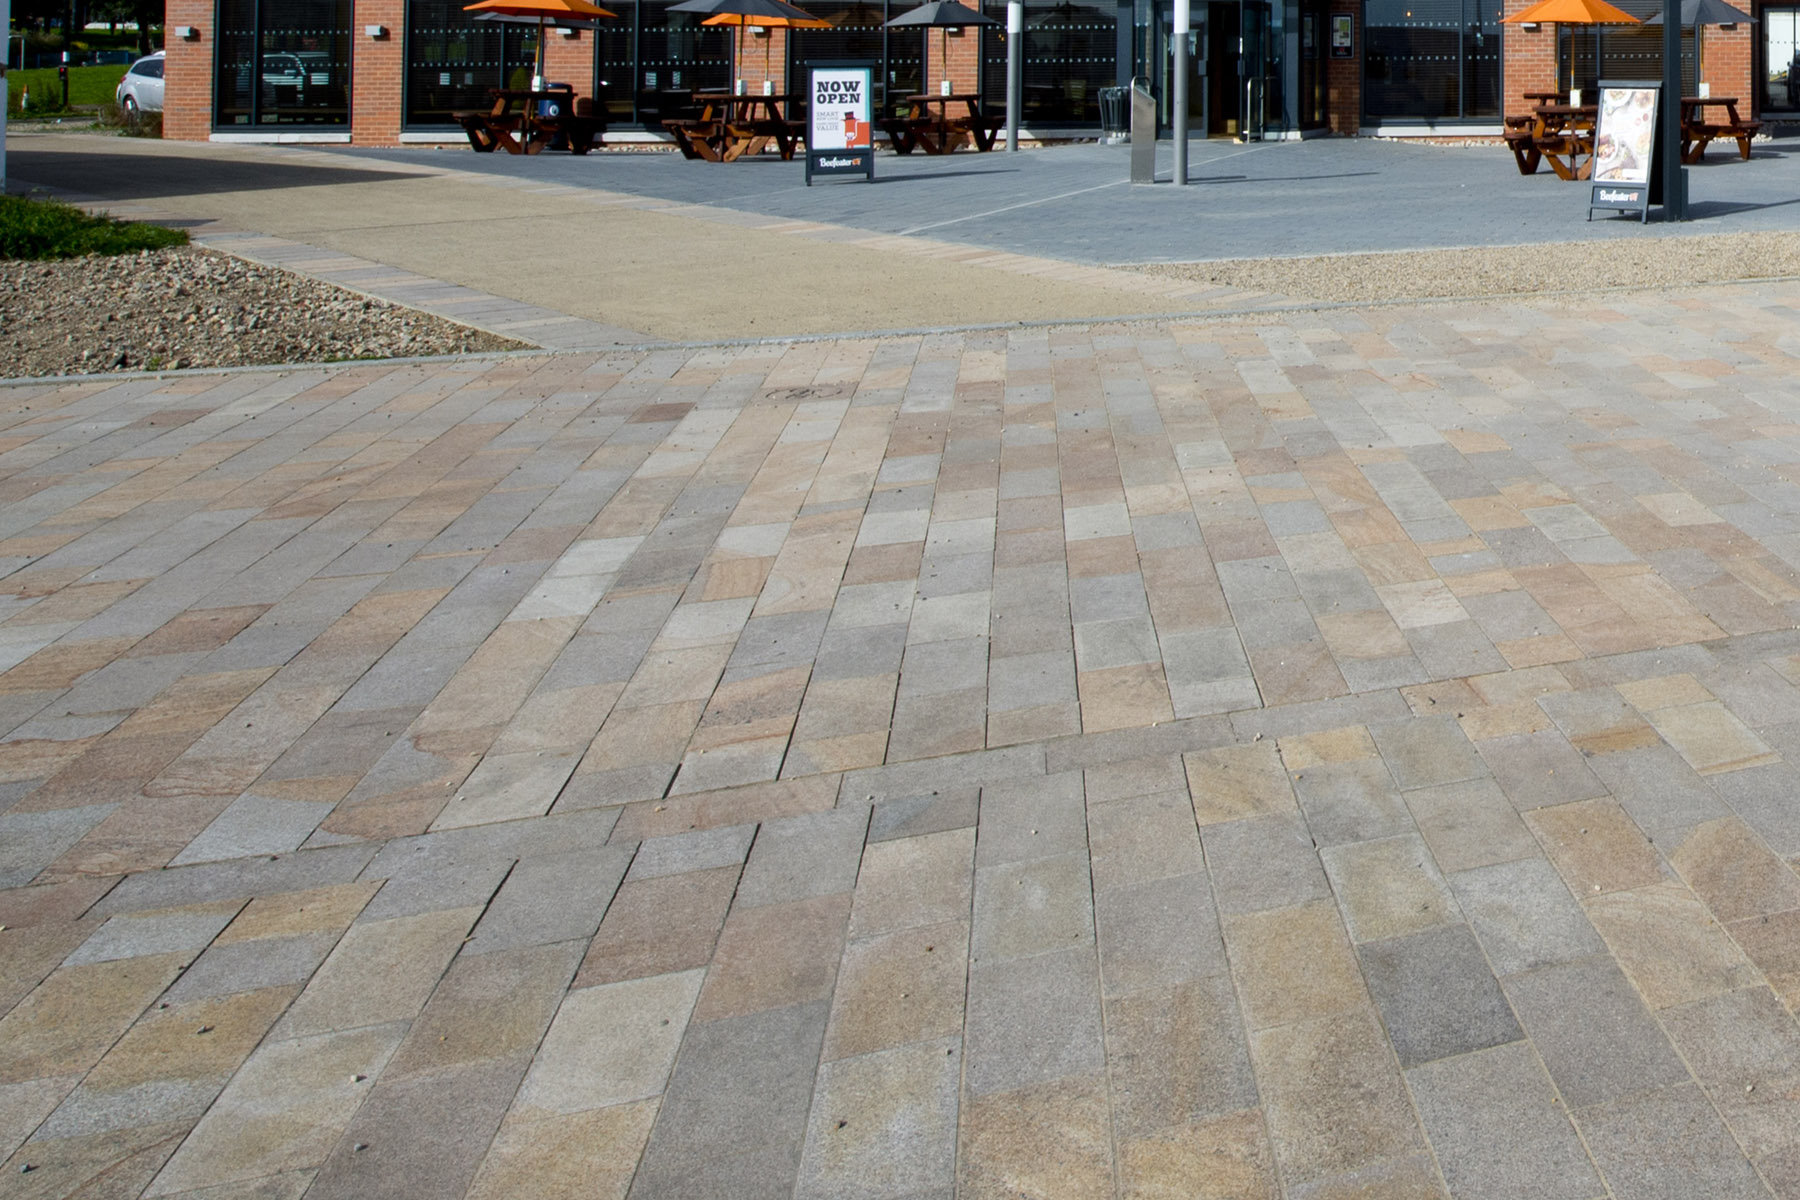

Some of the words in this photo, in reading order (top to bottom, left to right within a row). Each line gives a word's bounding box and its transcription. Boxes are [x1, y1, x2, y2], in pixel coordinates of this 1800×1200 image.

[816, 80, 861, 93] NOW
[816, 93, 861, 105] OPEN
[819, 156, 852, 168] Beefeater
[1599, 189, 1630, 203] Beefeater
